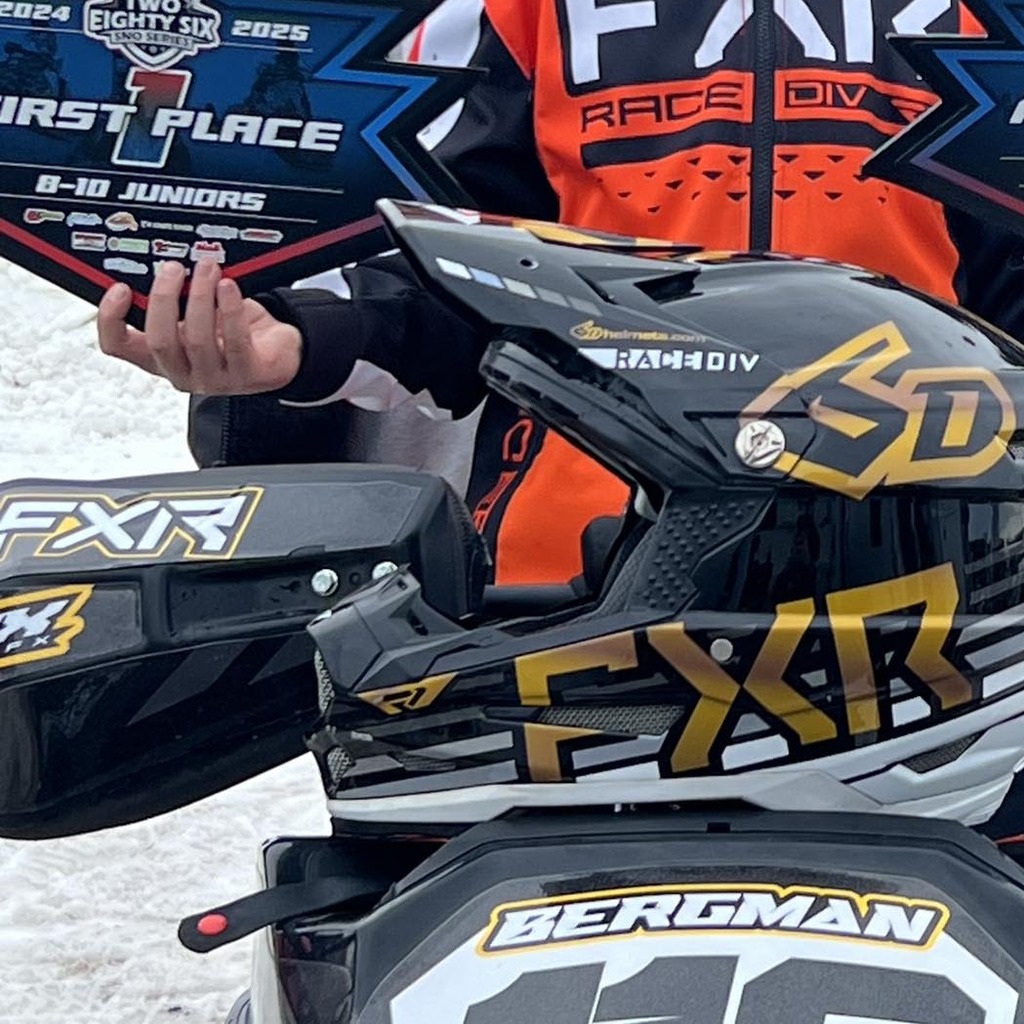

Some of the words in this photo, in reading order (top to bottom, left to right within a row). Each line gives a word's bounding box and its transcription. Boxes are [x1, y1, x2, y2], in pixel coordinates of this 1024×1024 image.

[0, 2, 71, 22] 2024
[90, 9, 175, 31] EIGHTY
[178, 17, 214, 40] SIX
[231, 19, 311, 41] 2025
[0, 96, 138, 133] IRST
[151, 109, 343, 151] PLACE
[581, 82, 742, 133] RACE
[35, 175, 110, 198] 8-10
[118, 185, 266, 211] JUNIORS
[706, 351, 760, 372] DIV
[0, 494, 248, 552] FXR
[514, 564, 975, 782] FXR
[488, 890, 939, 949] BERGMAN
